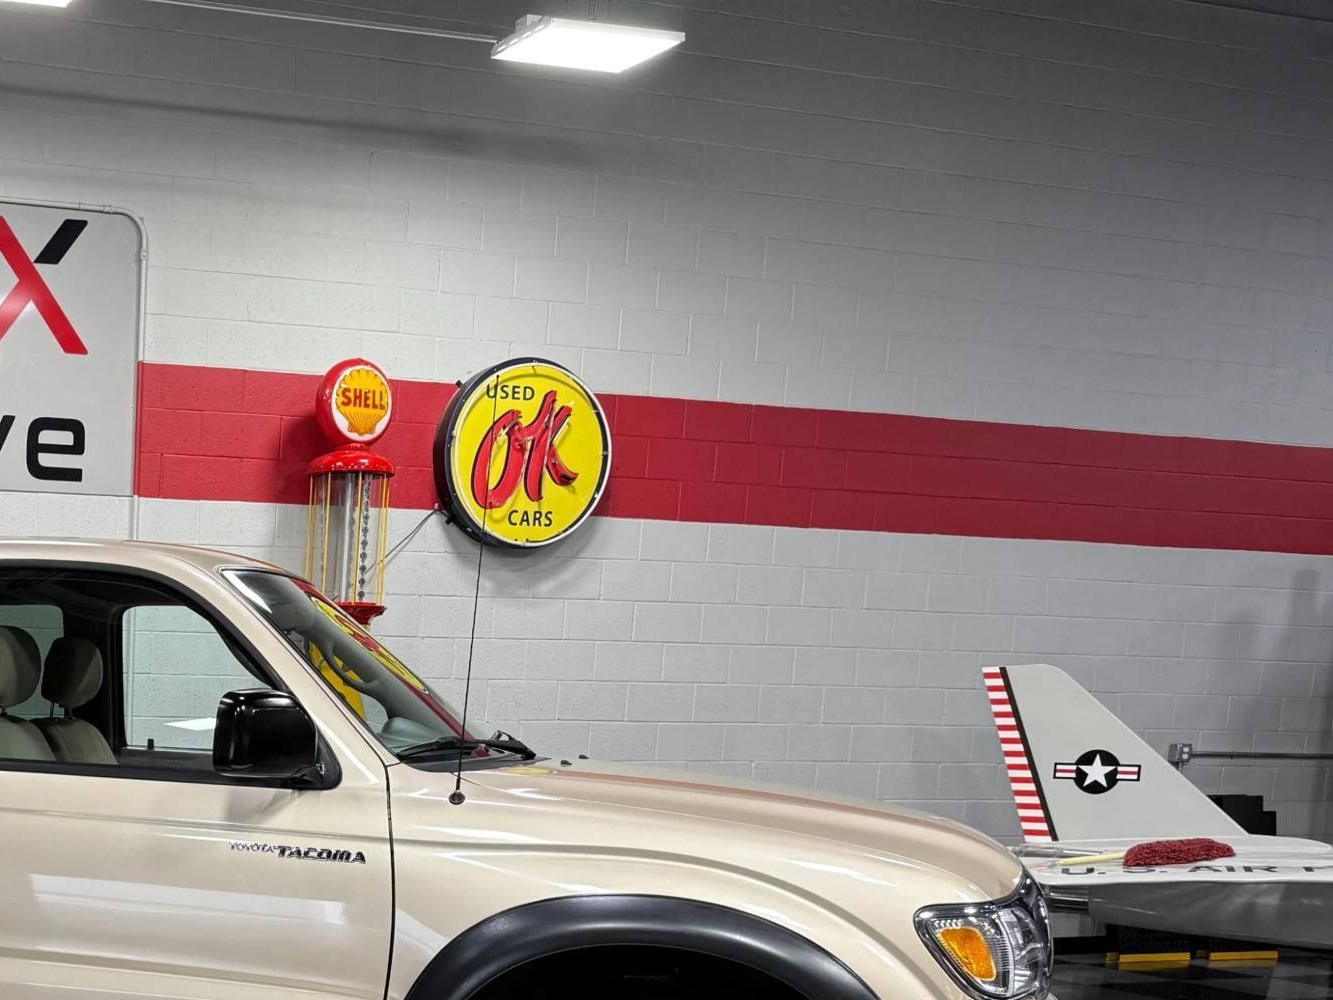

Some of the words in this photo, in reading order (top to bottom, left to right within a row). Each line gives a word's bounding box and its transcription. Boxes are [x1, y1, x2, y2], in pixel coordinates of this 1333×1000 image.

[340, 387, 386, 410] SHELL
[486, 383, 535, 401] USED
[471, 390, 579, 510] OK
[507, 510, 553, 528] CARS
[229, 841, 276, 854] TOYOTA
[277, 845, 367, 864] TACOMA
[1187, 865, 1279, 873] AIR
